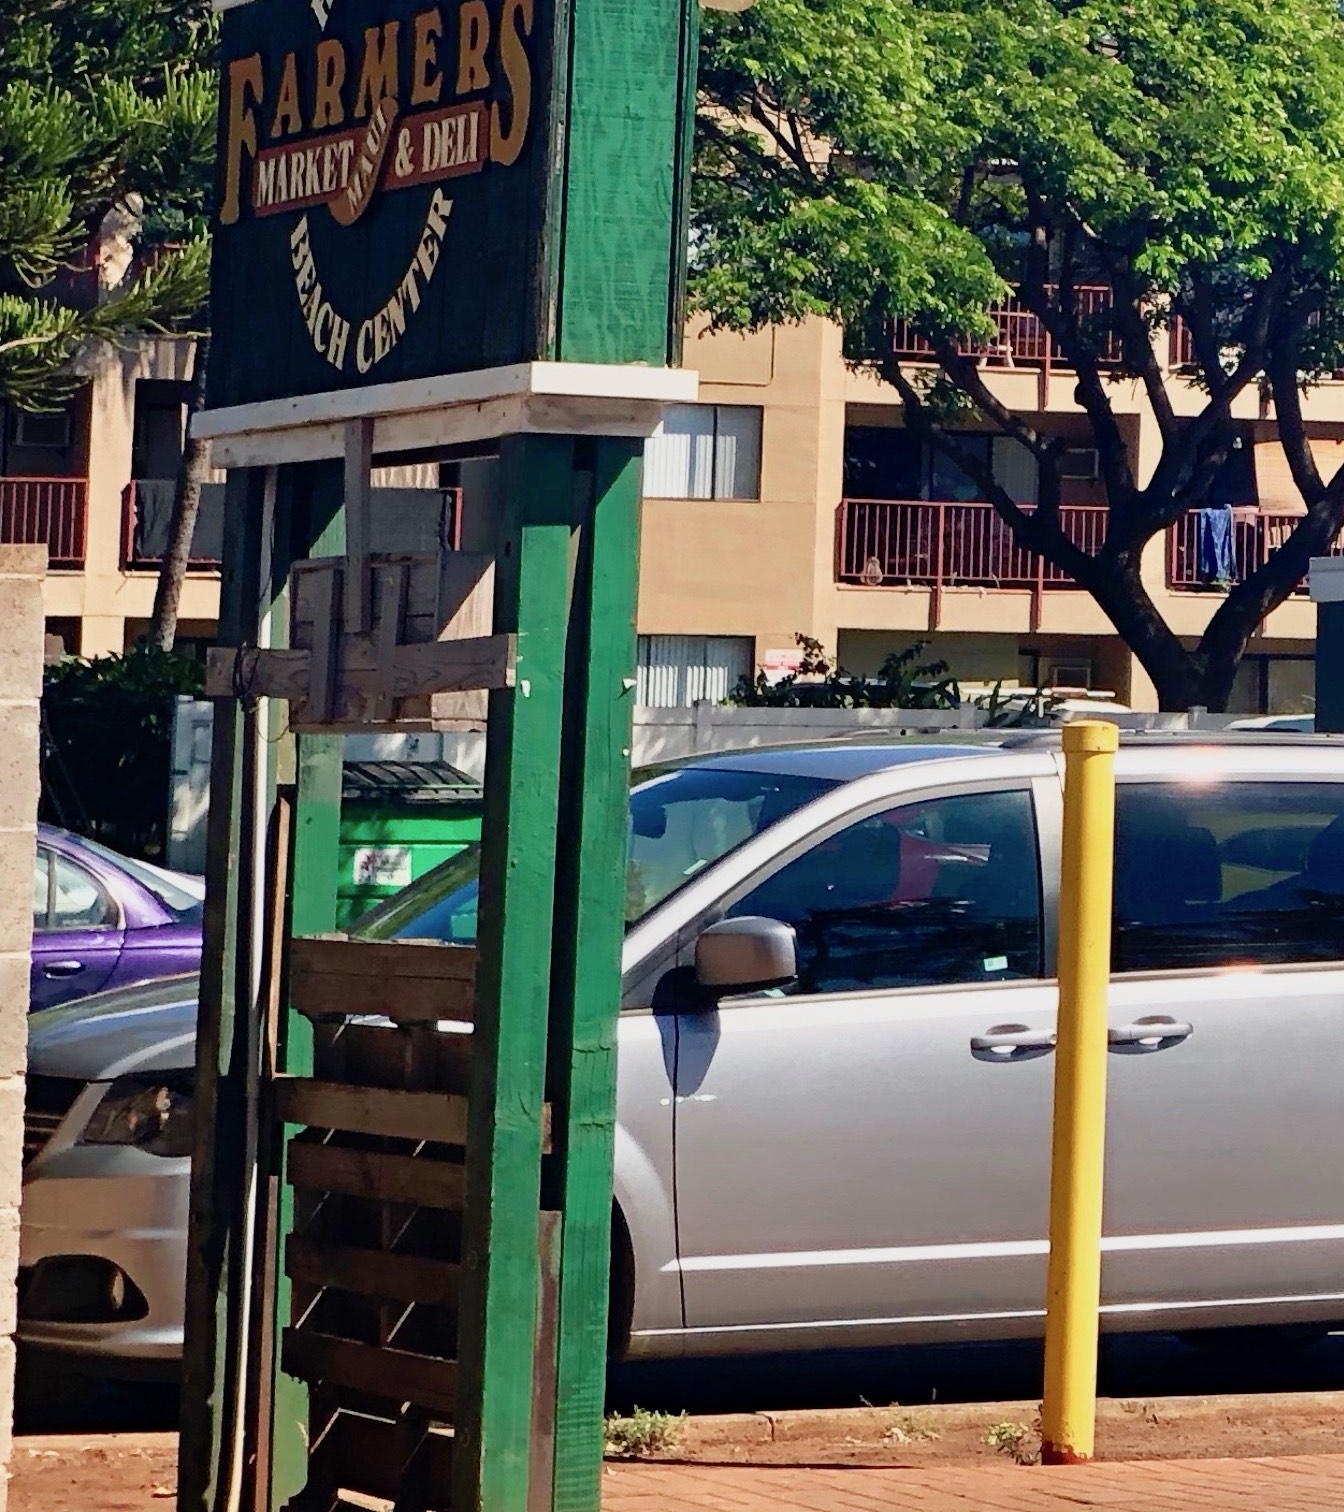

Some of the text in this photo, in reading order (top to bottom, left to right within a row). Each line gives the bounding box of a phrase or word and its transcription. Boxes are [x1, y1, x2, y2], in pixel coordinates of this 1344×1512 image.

[257, 111, 480, 208] MARKET & DELI
[347, 103, 388, 215] MAUI
[290, 187, 453, 374] BEACH CENTER
